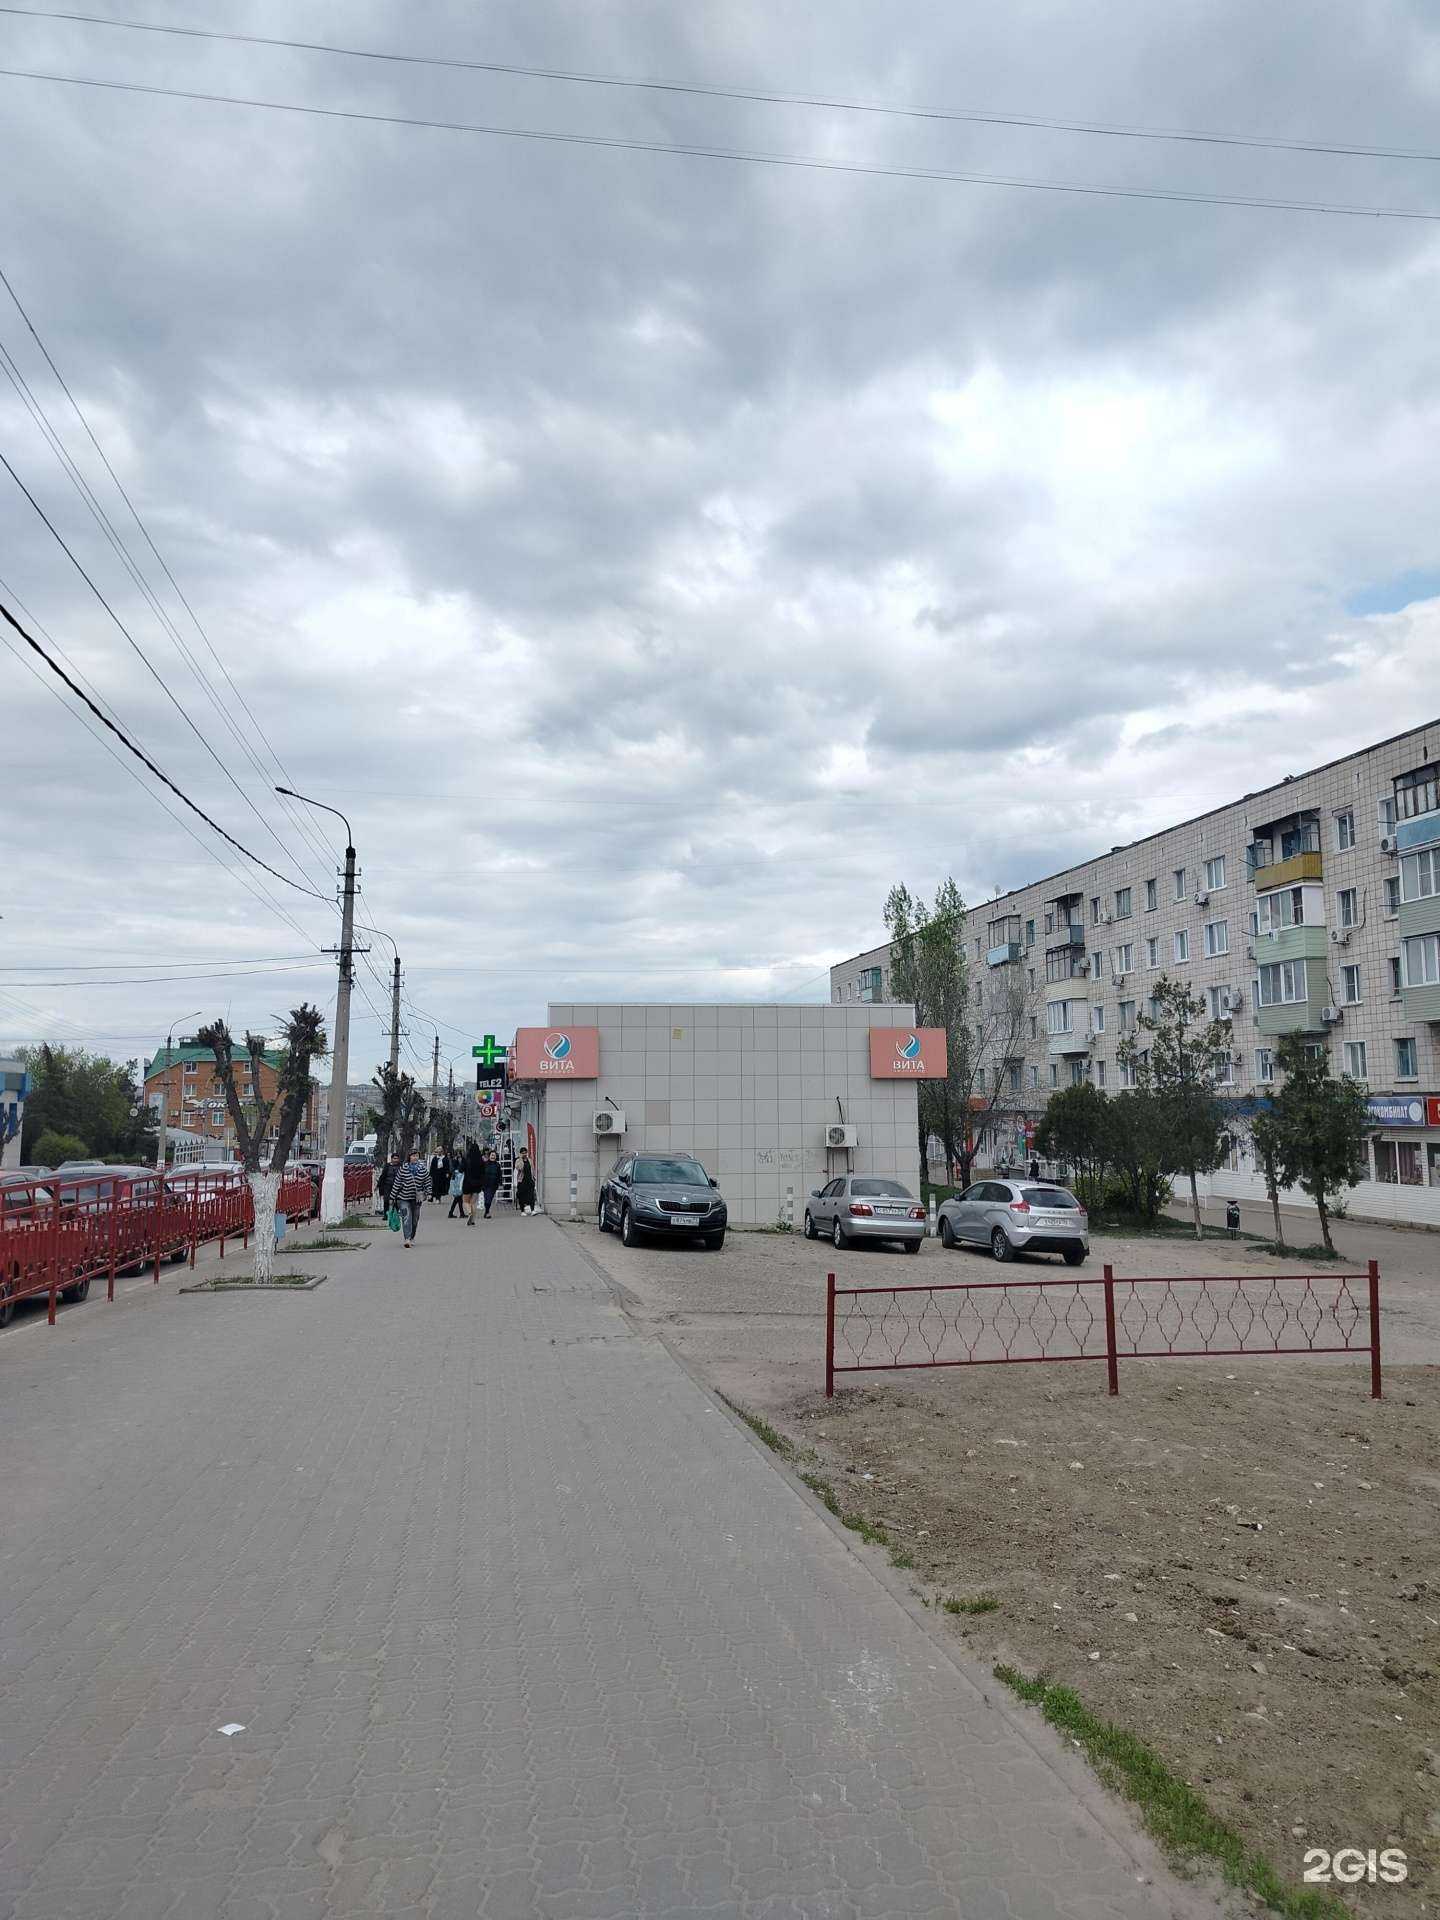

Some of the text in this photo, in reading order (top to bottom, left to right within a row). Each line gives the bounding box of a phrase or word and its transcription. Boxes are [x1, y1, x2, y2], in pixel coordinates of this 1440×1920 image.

[540, 1060, 574, 1070] ВИТА
[893, 1060, 925, 1069] ВИТА
[480, 1079, 502, 1088] TELE2
